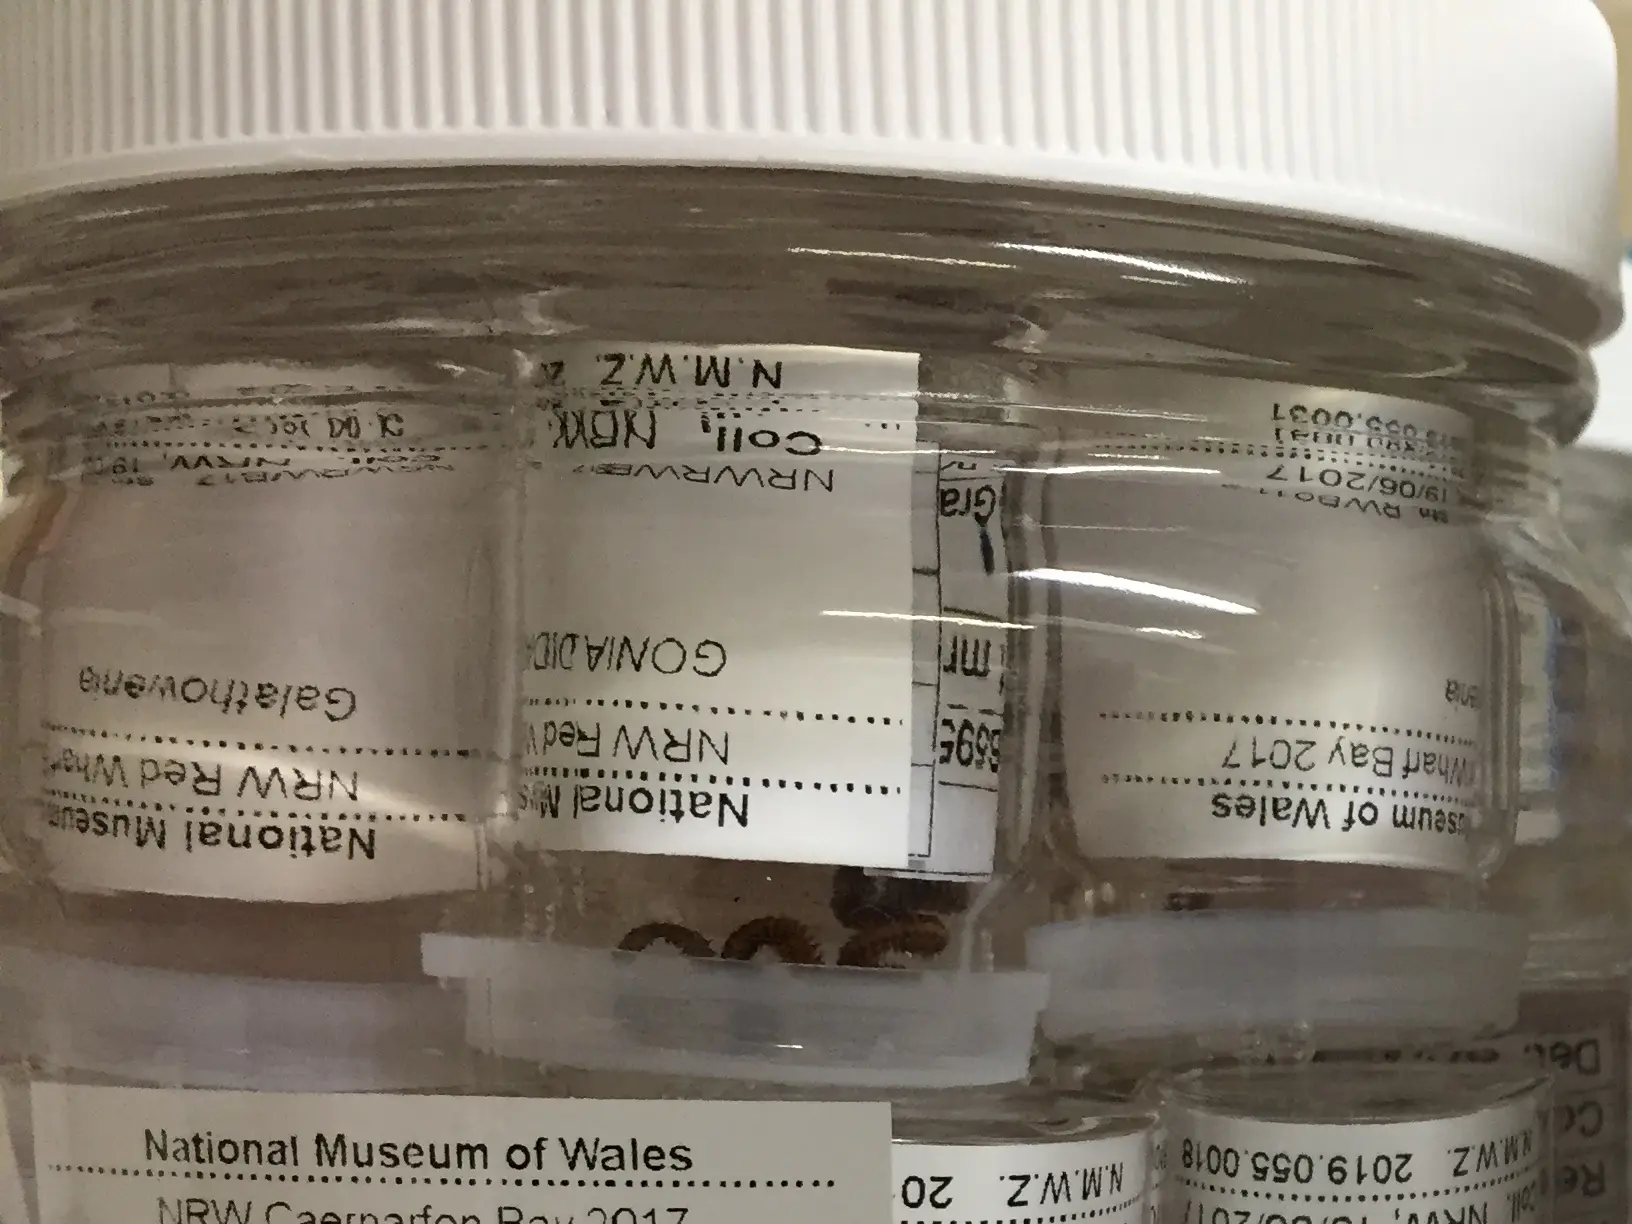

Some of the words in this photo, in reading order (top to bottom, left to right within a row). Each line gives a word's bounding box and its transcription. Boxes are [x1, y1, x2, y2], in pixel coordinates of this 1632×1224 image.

[543, 721, 600, 754] Red
[614, 726, 729, 764] NRW
[1222, 738, 1316, 770] 2017
[1328, 737, 1393, 777] Bay
[140, 757, 221, 796] Red
[237, 764, 358, 801] NRW
[573, 785, 750, 827] National
[1210, 794, 1330, 828] Wales
[1341, 801, 1379, 832] of
[185, 819, 376, 860] National
[144, 1129, 299, 1169] National
[316, 1133, 489, 1171] Museum
[506, 1138, 548, 1171] of
[559, 1138, 694, 1172] Wales
[1181, 1139, 1413, 1185] 2019.055.0018
[999, 1162, 1124, 1208] N.M.W.Z.
